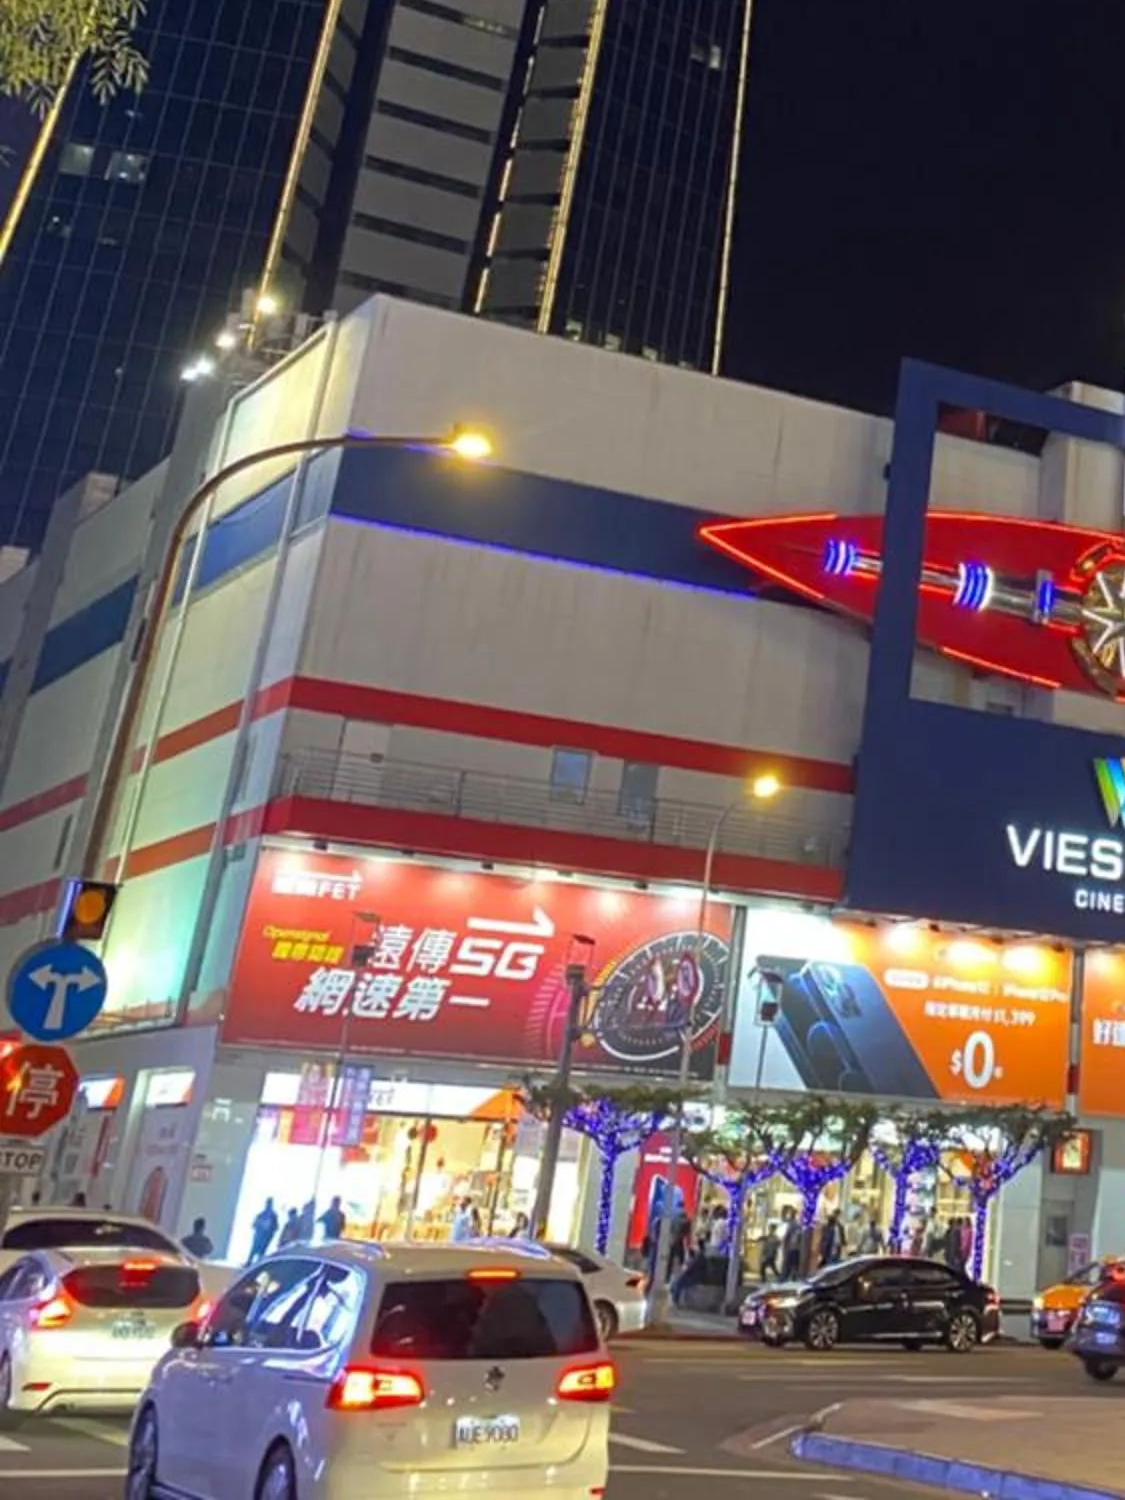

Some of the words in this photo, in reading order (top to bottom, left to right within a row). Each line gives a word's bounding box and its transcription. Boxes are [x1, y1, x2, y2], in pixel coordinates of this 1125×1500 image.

[293, 967, 491, 1021] 網速第一
[6, 1060, 65, 1120] 停
[0, 1152, 43, 1171] TOP
